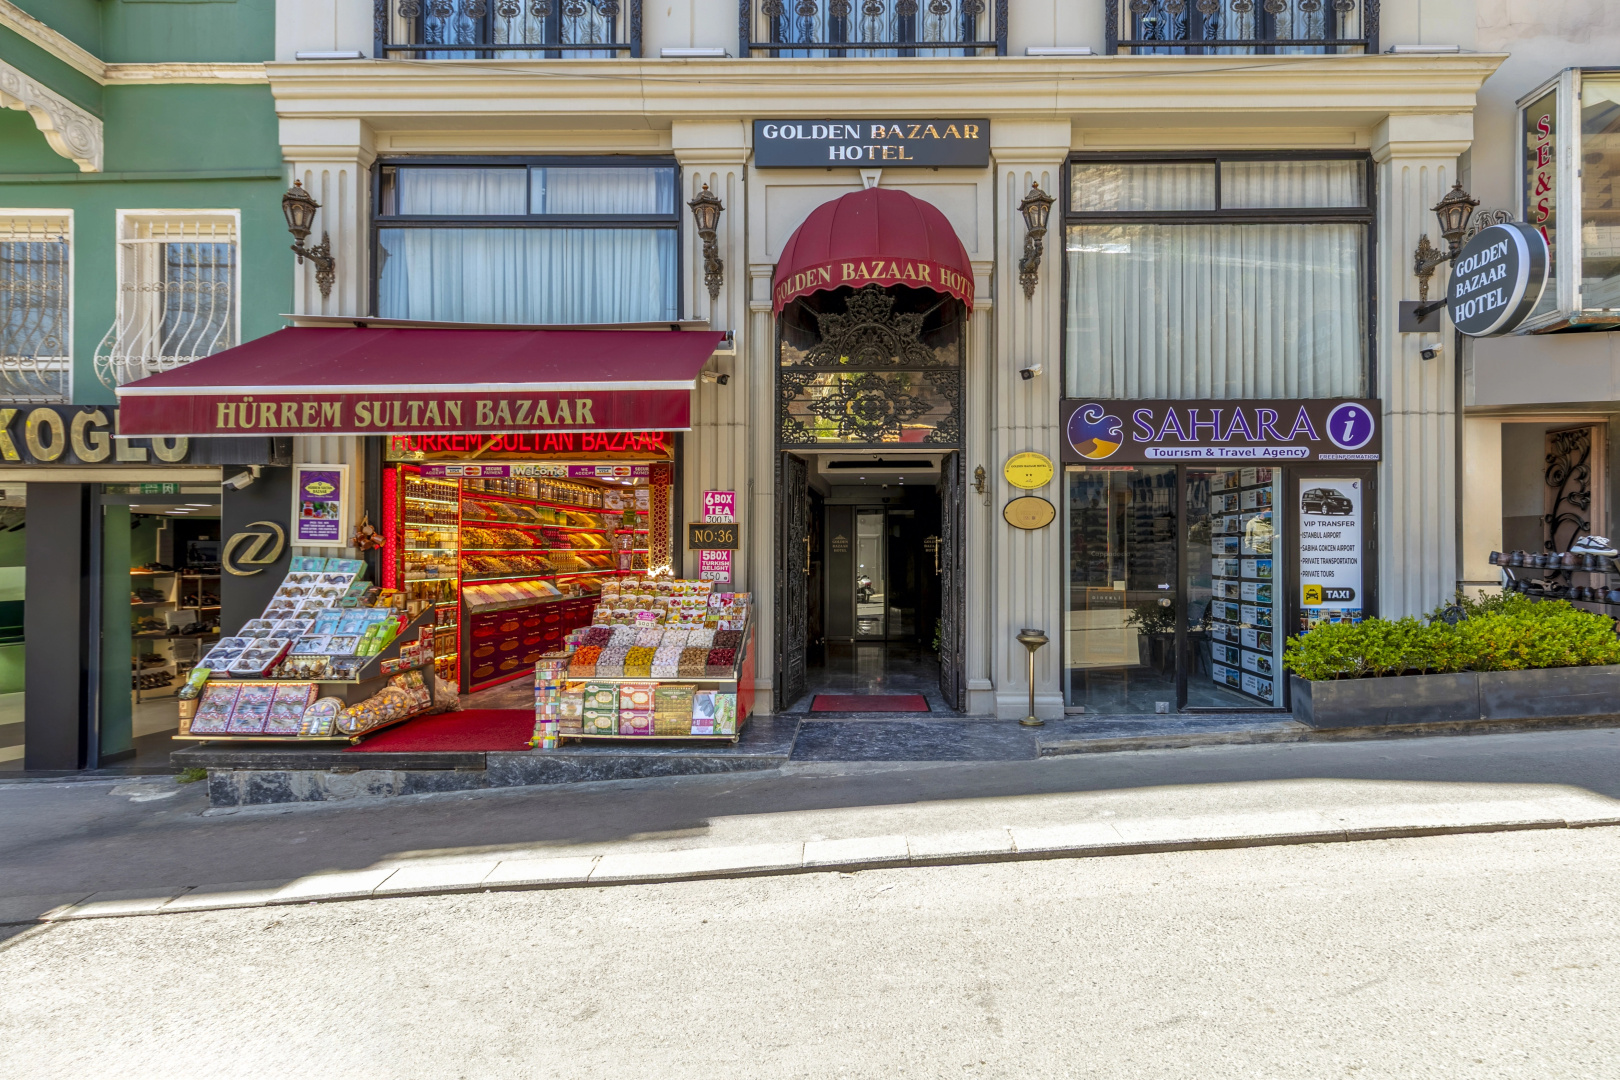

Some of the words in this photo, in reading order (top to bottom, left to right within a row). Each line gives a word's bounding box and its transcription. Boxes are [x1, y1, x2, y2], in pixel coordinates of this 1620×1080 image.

[763, 124, 861, 140] GOLDEN
[871, 124, 979, 139] BAZAAR
[829, 145, 914, 160] HOTEL
[1456, 239, 1508, 278] GOLDEN
[776, 265, 832, 304] GOLDEN
[841, 261, 932, 283] BAZAAR
[1456, 263, 1507, 298] BAZAAR
[1455, 287, 1508, 324] HOTEL
[216, 396, 342, 428] HÜRREM
[354, 399, 463, 428] SULTAN
[475, 397, 596, 427] BAZAAR
[1132, 405, 1321, 443] SAHARA
[489, 432, 573, 451] SULTAN
[582, 431, 665, 451] BAZAAR
[1152, 448, 1202, 457] Tourism
[1205, 448, 1214, 457] &
[1218, 448, 1256, 457] Travel
[1262, 448, 1307, 459] Agency
[515, 466, 564, 477] Welcome
[715, 494, 732, 503] BOX
[707, 506, 731, 514] TEA
[706, 515, 722, 524] 300
[695, 530, 733, 542] NO:36
[1323, 531, 1342, 539] AIRPORT
[1336, 544, 1355, 552] AIRPORT
[1302, 557, 1320, 565] PRIVATE
[1320, 557, 1358, 565] TRANSPORTATION
[703, 571, 721, 581] 350
[1302, 570, 1320, 578] PRIVATE
[1320, 570, 1335, 578] TOURS
[1326, 590, 1350, 599] TAXI
